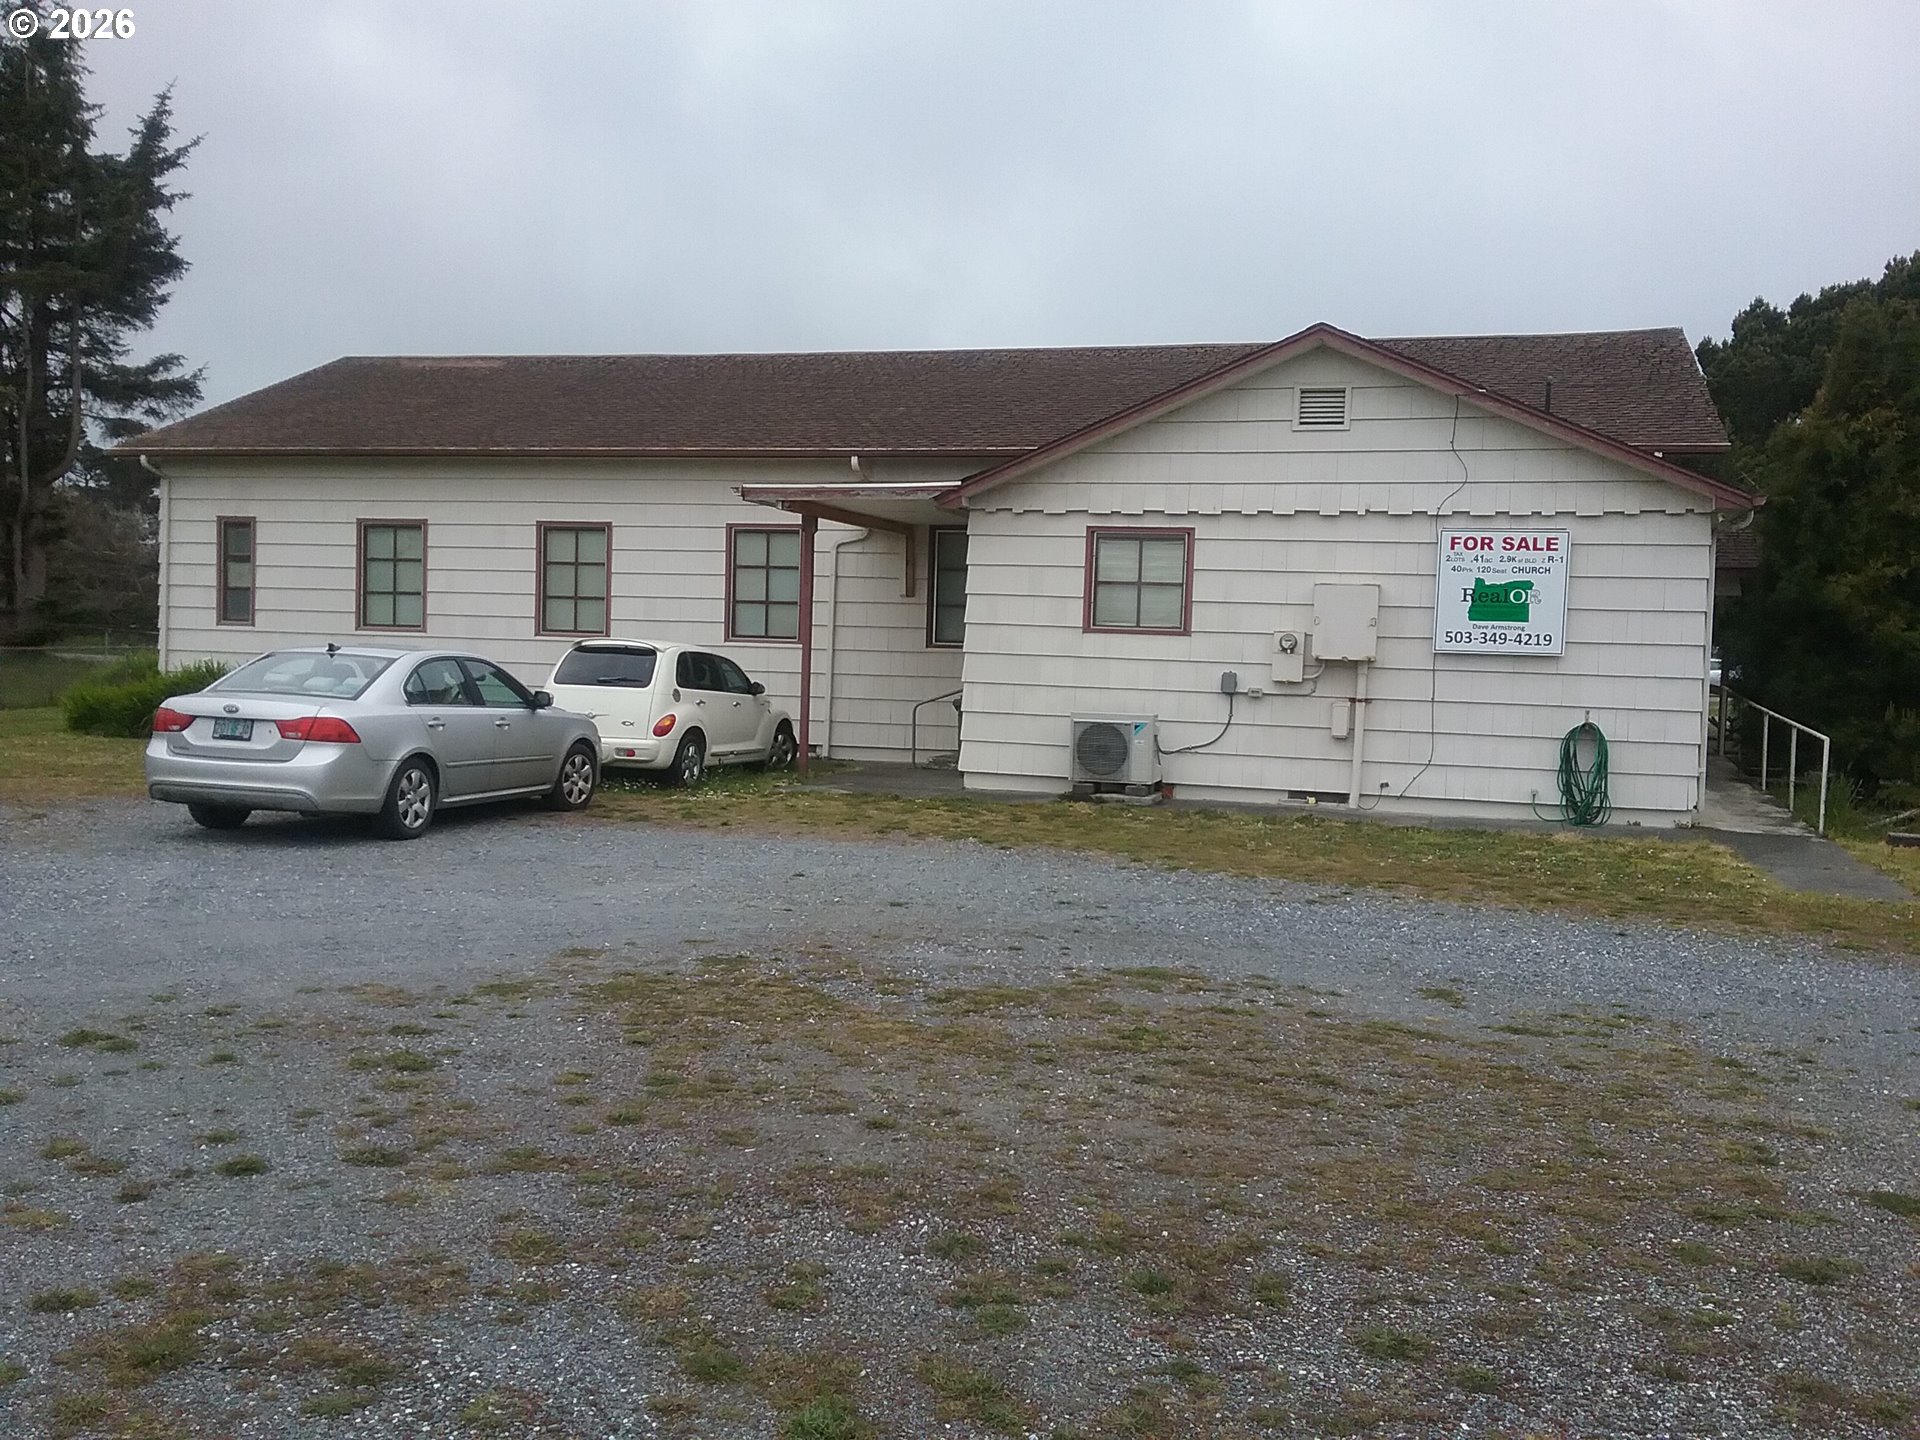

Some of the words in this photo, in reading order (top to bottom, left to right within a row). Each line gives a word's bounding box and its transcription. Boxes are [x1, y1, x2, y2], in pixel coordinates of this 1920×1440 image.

[1450, 536, 1494, 551] FOR
[1501, 536, 1559, 551] SALE
[1511, 566, 1551, 574] CHURCH
[1490, 624, 1526, 632] Armstrong
[1444, 631, 1553, 646] 503-349-4219
